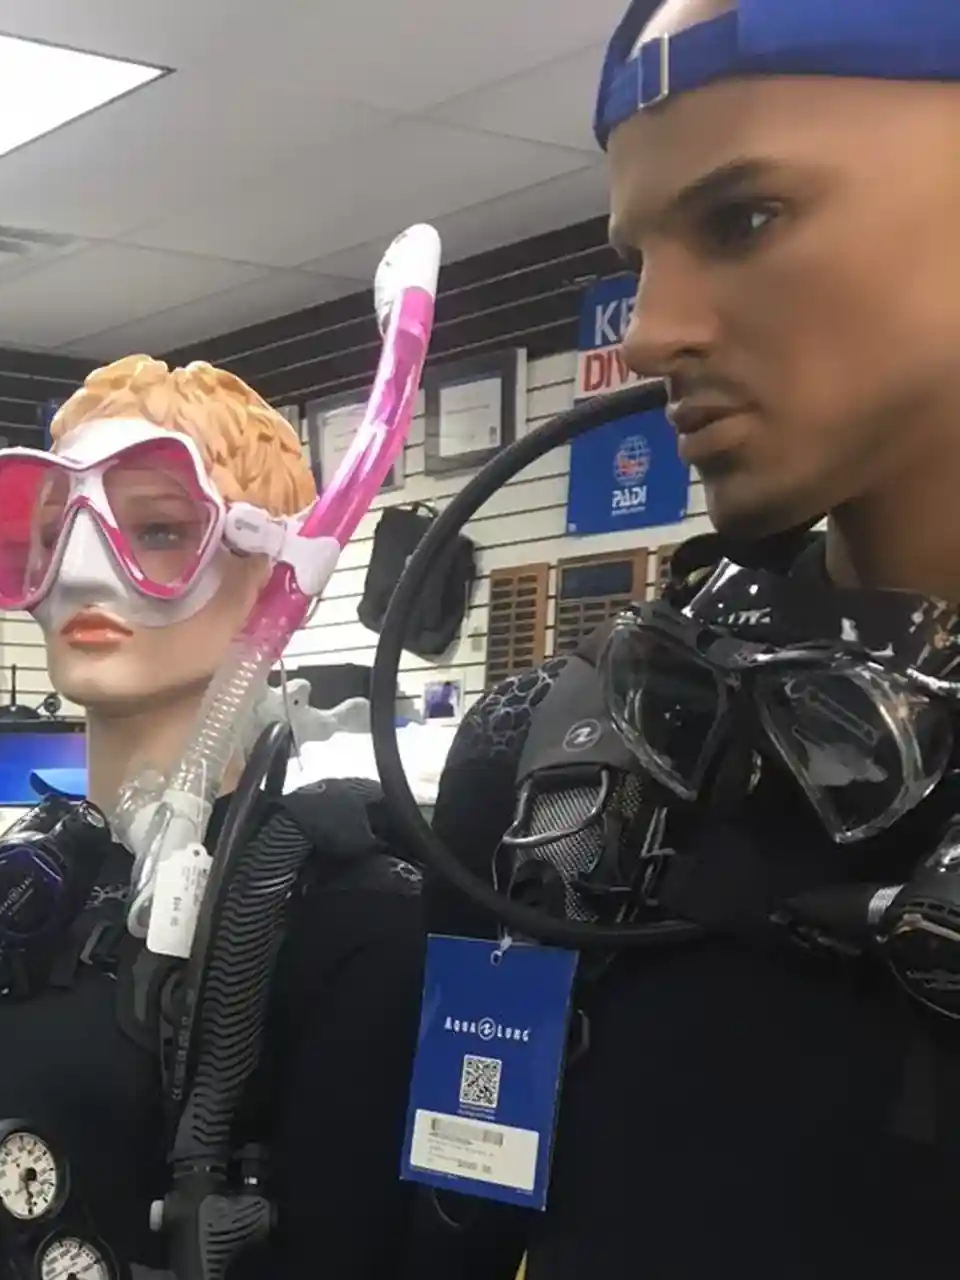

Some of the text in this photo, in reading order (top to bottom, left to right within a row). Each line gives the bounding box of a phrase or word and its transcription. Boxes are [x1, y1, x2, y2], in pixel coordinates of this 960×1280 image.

[611, 485, 648, 508] PADI
[444, 1016, 530, 1042] AQUA LUNG
